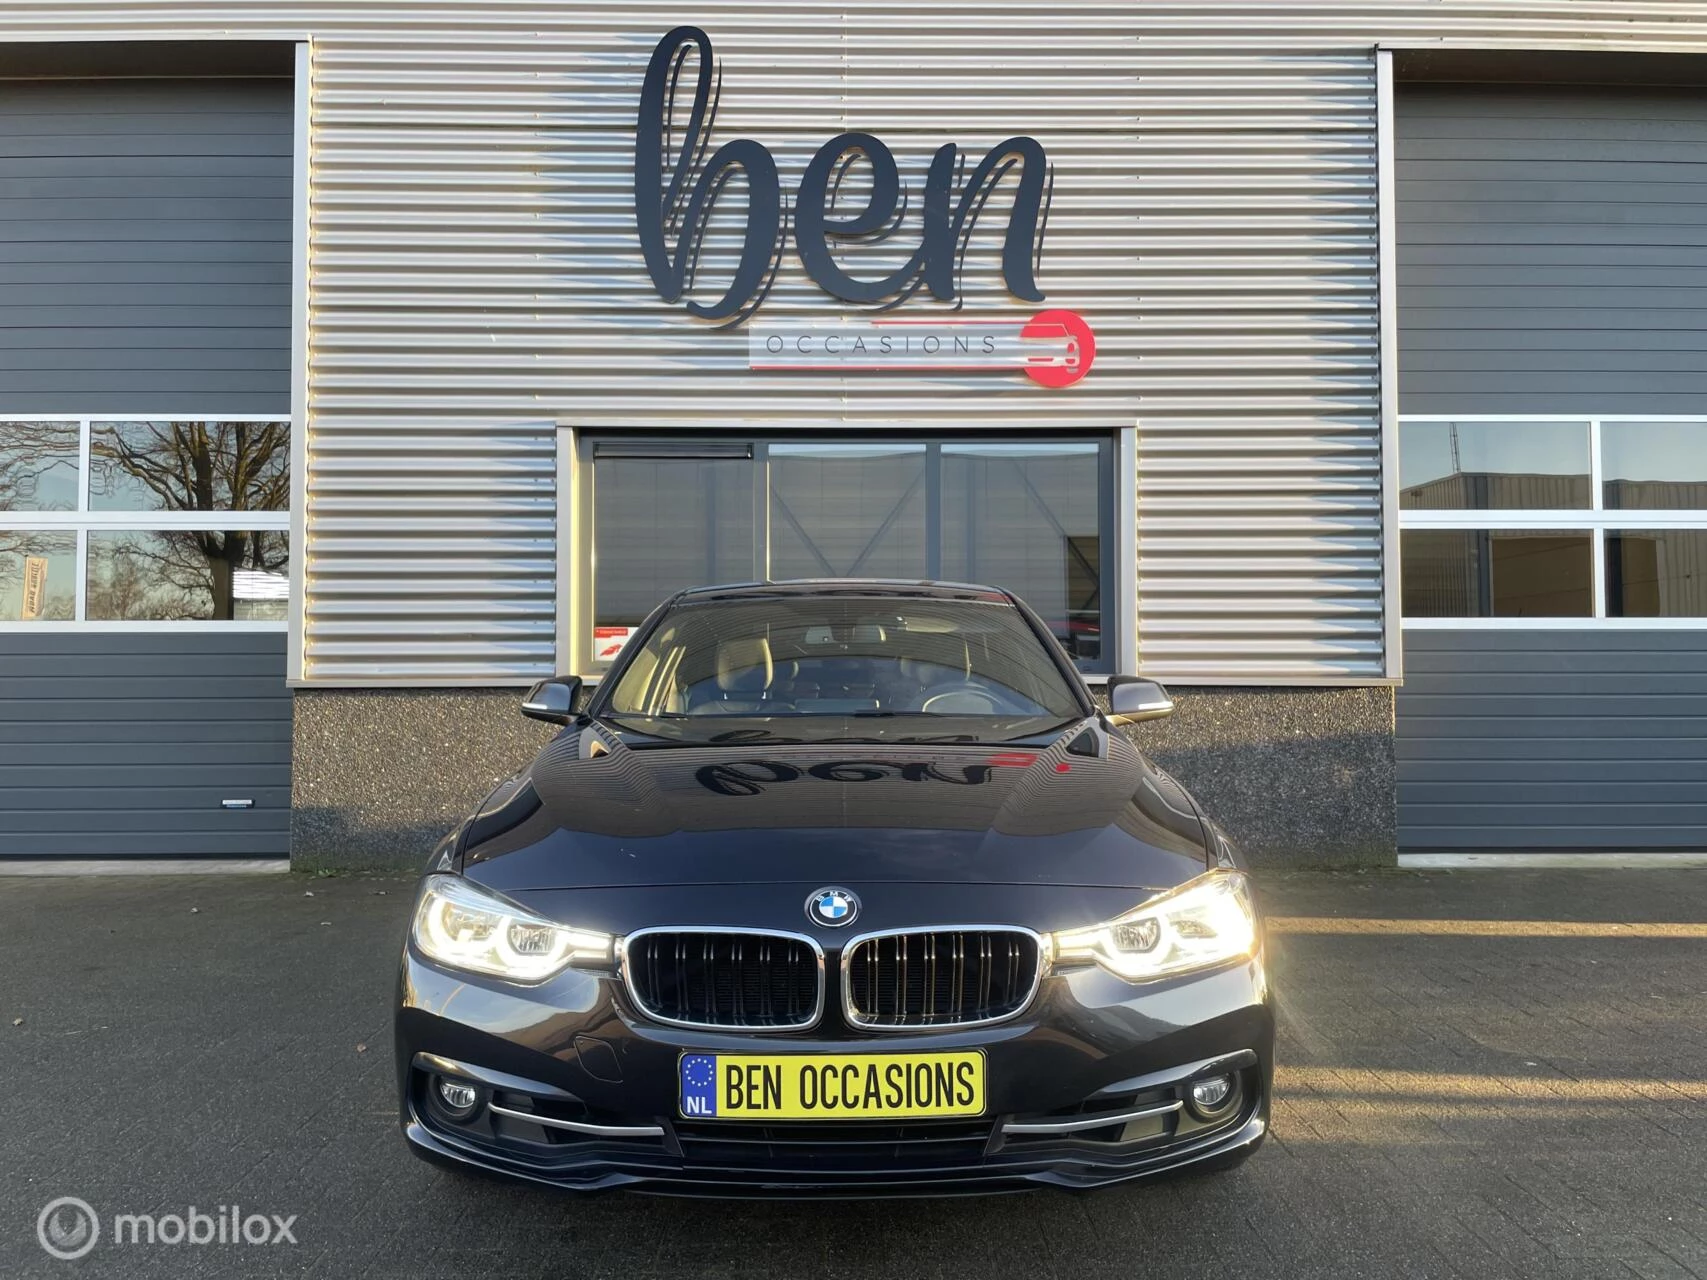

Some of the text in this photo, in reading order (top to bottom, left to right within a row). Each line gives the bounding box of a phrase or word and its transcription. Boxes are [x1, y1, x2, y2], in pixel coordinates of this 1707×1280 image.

[634, 25, 1053, 330] ben
[766, 335, 996, 354] OCCASIONS
[815, 890, 853, 902] BMW
[726, 1062, 975, 1110] BEN OCCASIONS
[686, 1096, 713, 1115] NL
